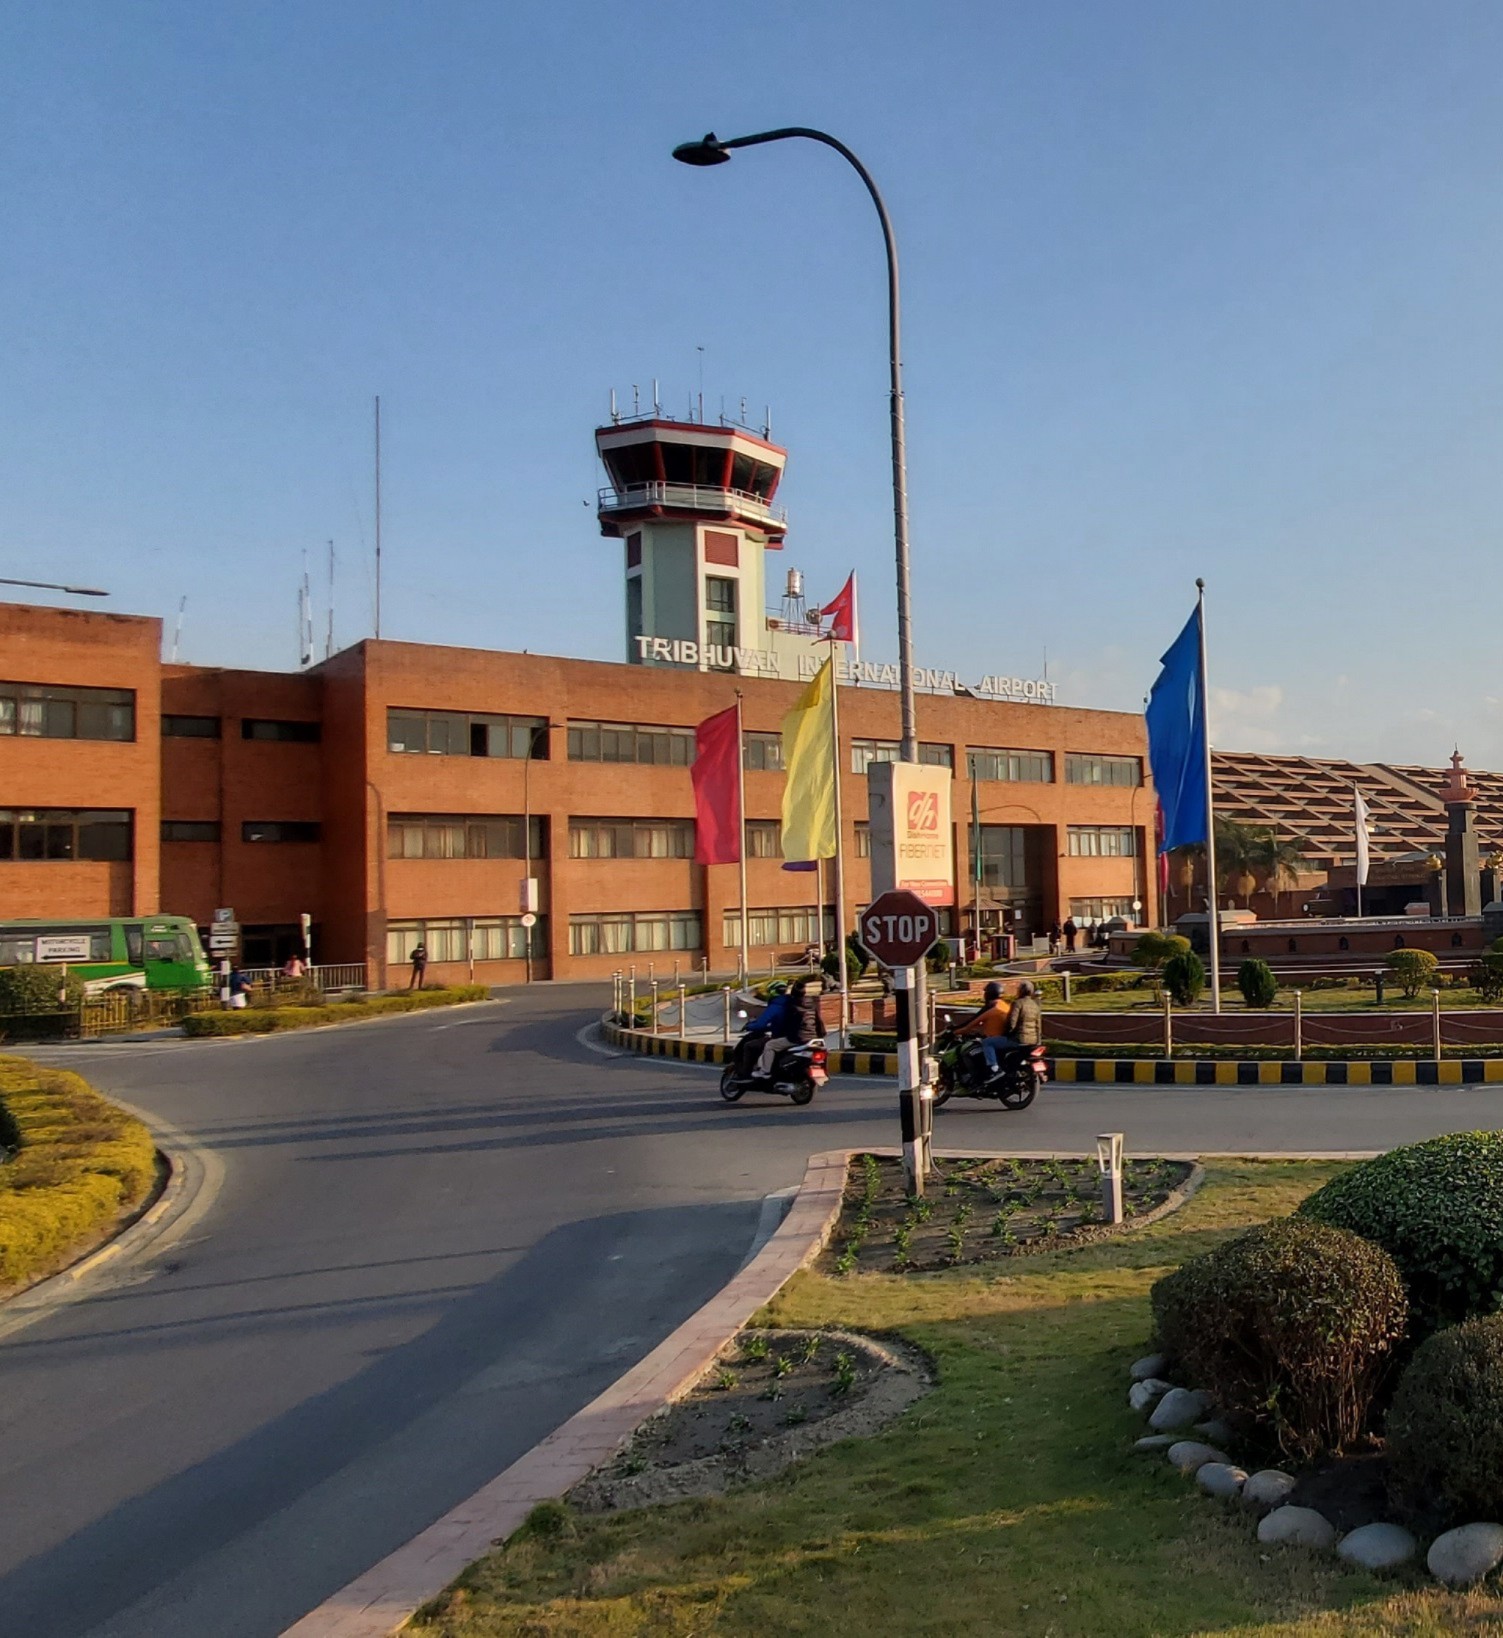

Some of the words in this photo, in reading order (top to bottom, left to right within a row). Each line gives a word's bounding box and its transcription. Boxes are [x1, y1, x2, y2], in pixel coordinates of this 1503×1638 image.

[634, 635, 779, 672] TRIBHUVAN
[979, 674, 1059, 700] AIRPORT
[866, 915, 930, 944] STOP
